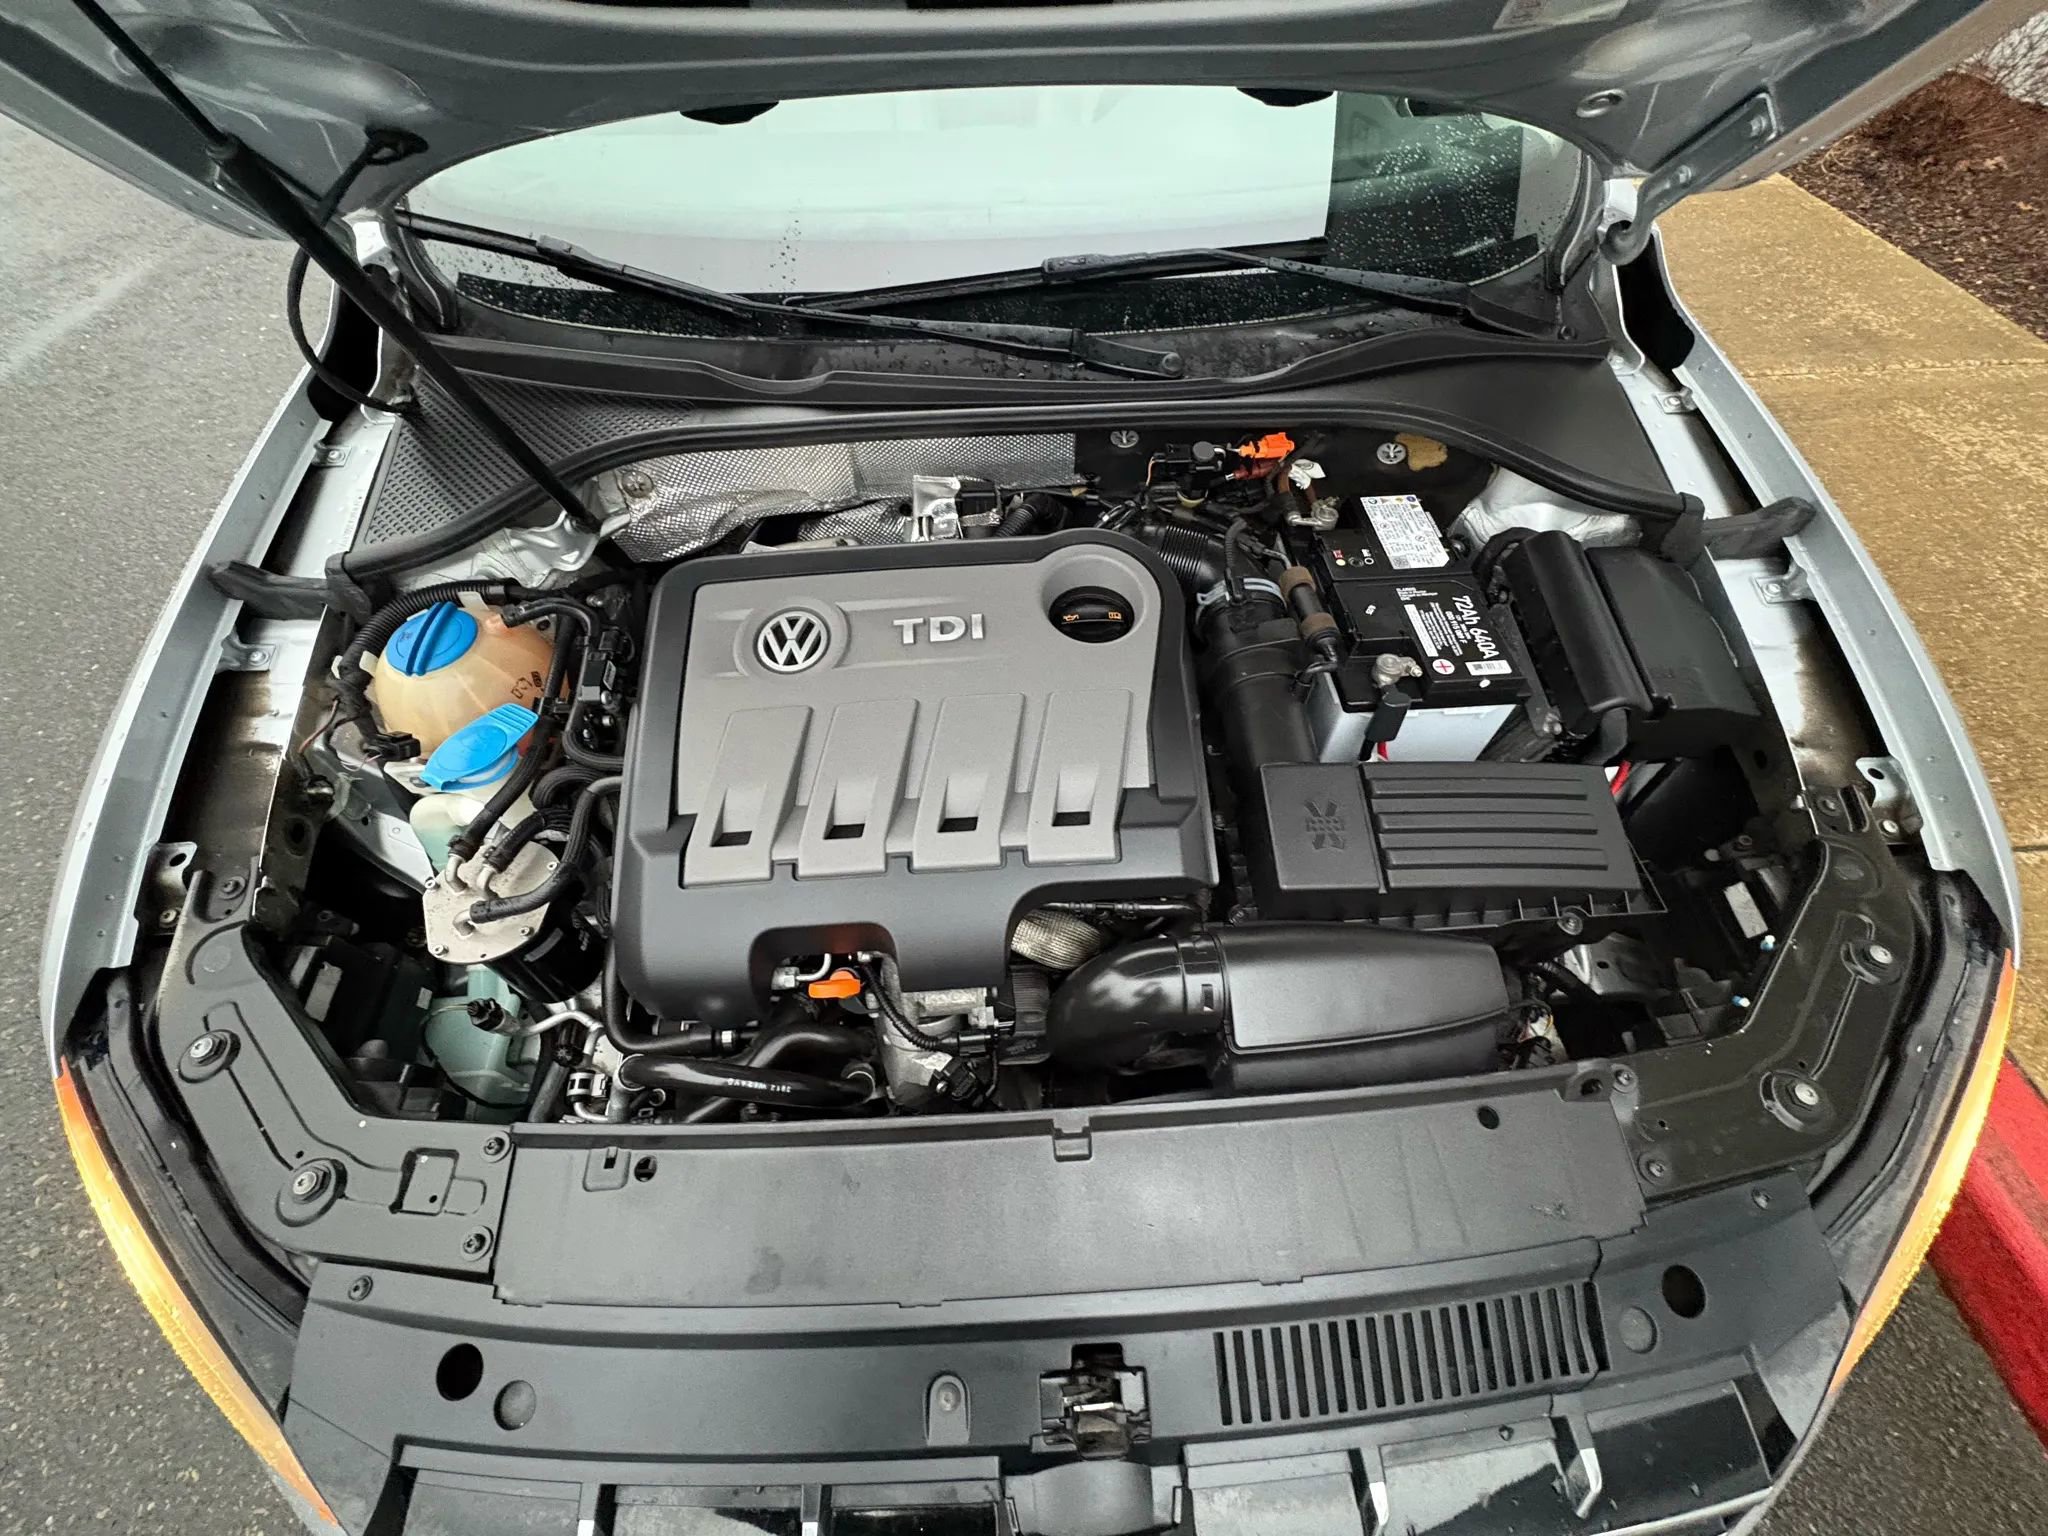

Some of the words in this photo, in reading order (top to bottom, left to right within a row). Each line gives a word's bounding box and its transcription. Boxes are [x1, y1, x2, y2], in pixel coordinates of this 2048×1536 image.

[757, 610, 828, 673] VW
[893, 613, 984, 645] TDI
[1452, 595, 1480, 625] 72Ah
[1469, 627, 1500, 659] 640A
